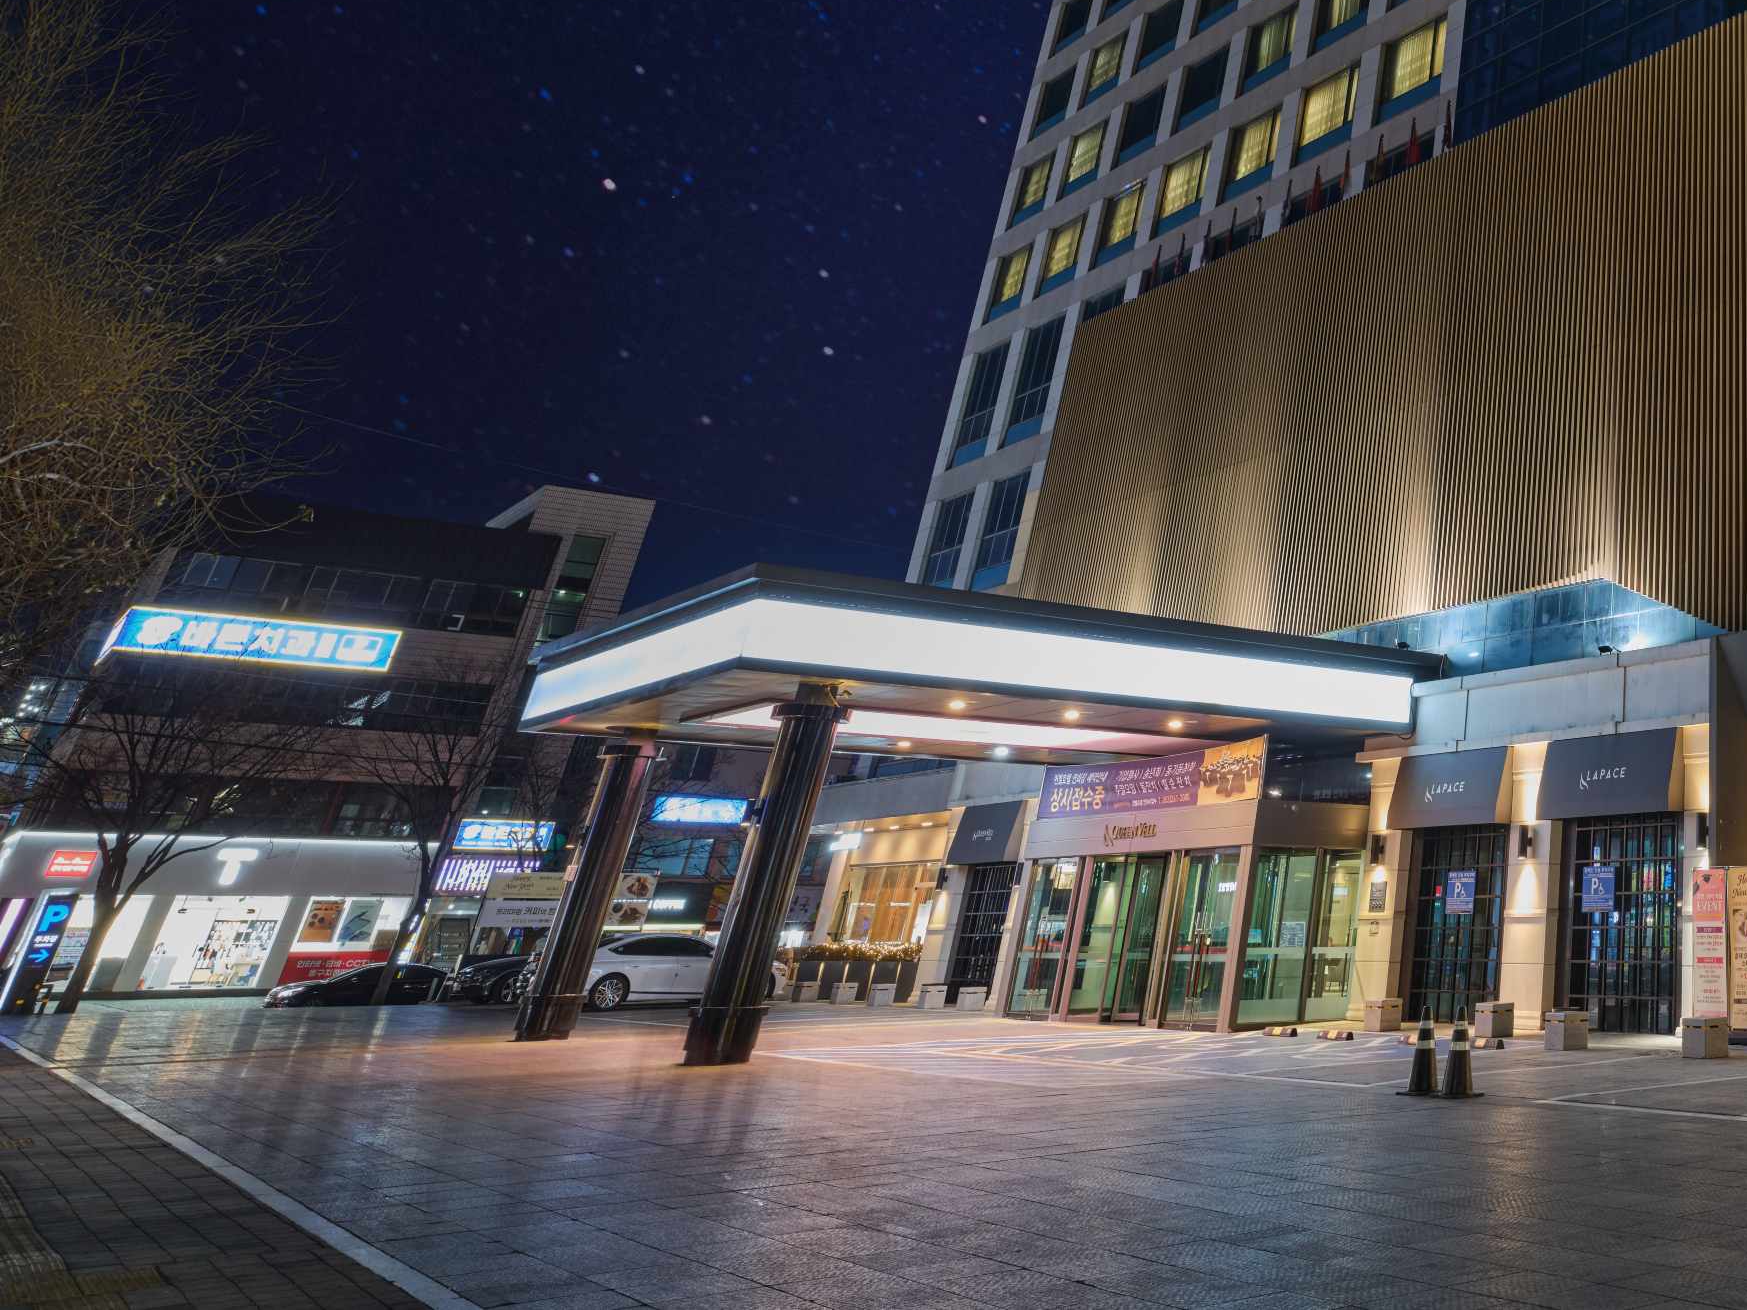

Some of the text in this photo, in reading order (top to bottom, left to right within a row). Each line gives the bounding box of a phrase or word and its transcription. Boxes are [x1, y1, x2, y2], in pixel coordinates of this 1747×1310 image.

[1586, 766, 1627, 782] LAPACE
[1430, 781, 1465, 795] LAPACE
[1050, 785, 1105, 812] 상시접수중
[1455, 882, 1462, 898] P
[1592, 877, 1599, 895] P
[1732, 887, 1747, 898] New
[37, 904, 70, 932] P
